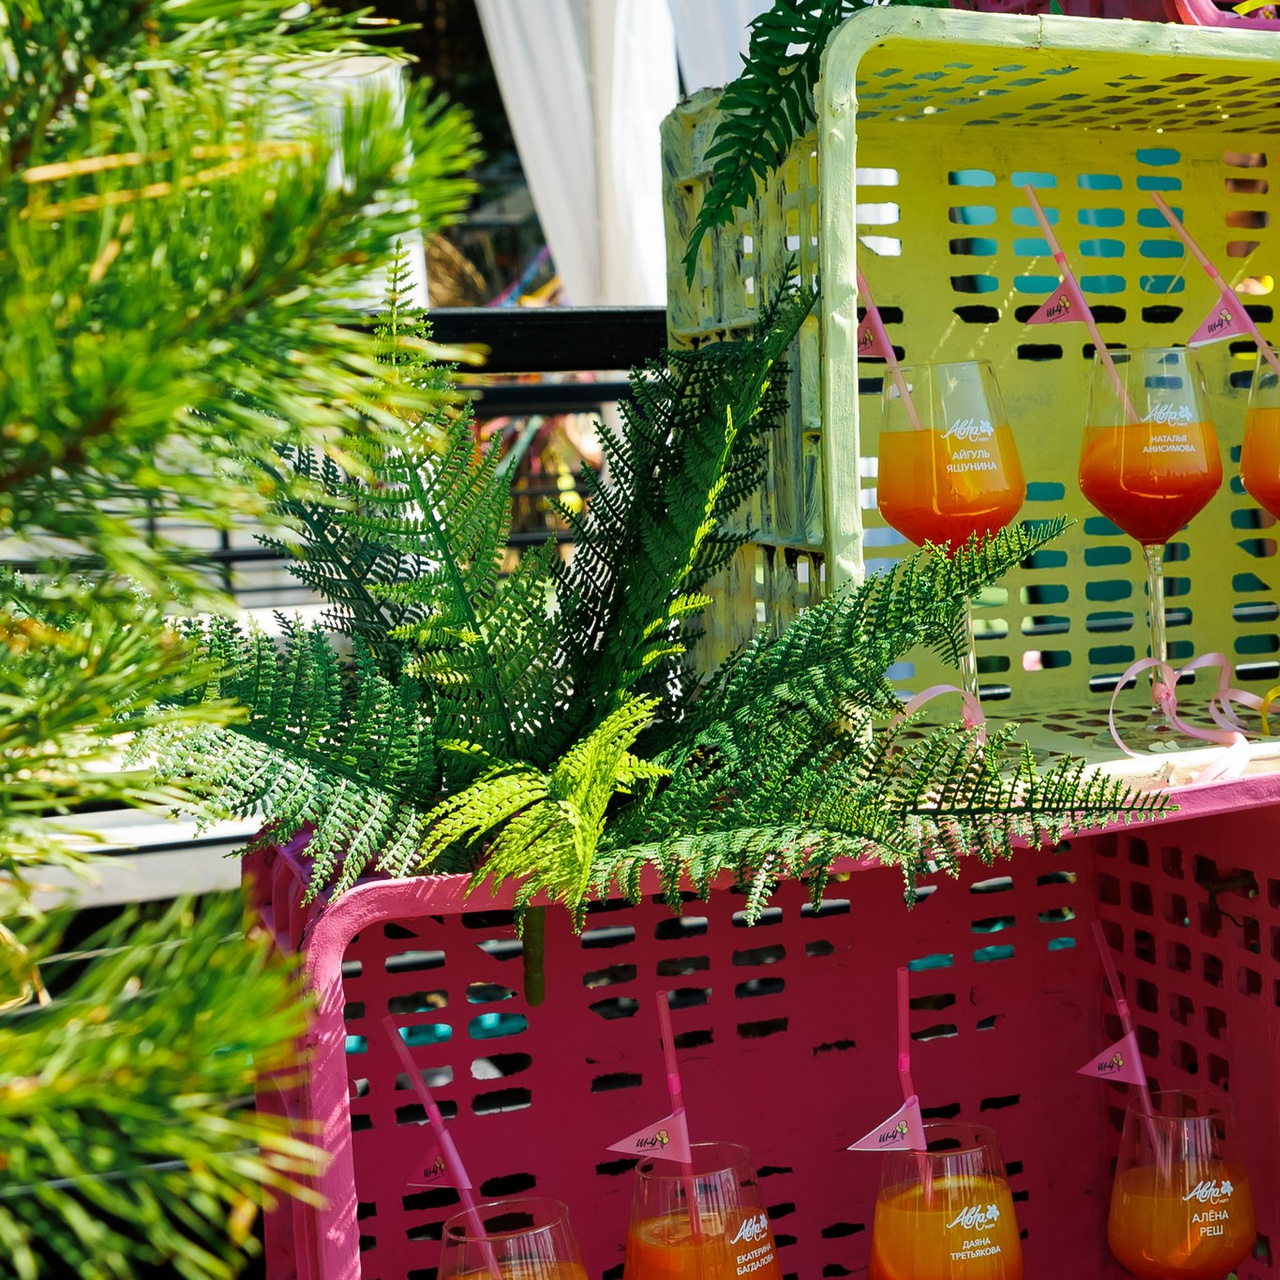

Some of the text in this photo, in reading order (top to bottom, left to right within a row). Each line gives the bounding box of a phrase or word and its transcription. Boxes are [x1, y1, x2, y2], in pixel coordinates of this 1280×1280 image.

[952, 449, 990, 460] АЙГУЛЬ
[1143, 444, 1196, 453] АНИСИМОВА
[946, 461, 997, 473] ЯШУНИНА
[1182, 1179, 1222, 1205] Aloha
[946, 1204, 988, 1231] Aloha
[1192, 1209, 1229, 1223] АЛЁНА
[730, 1215, 763, 1245] Aloha
[1200, 1224, 1224, 1237] РЕШ
[962, 1237, 991, 1250] ДАЯНА
[737, 1242, 771, 1264] ЕКАТЕРИНА
[950, 1245, 1001, 1261] ТРЕТЬЯКОВА
[737, 1253, 774, 1276] БАГДАЛОВА
